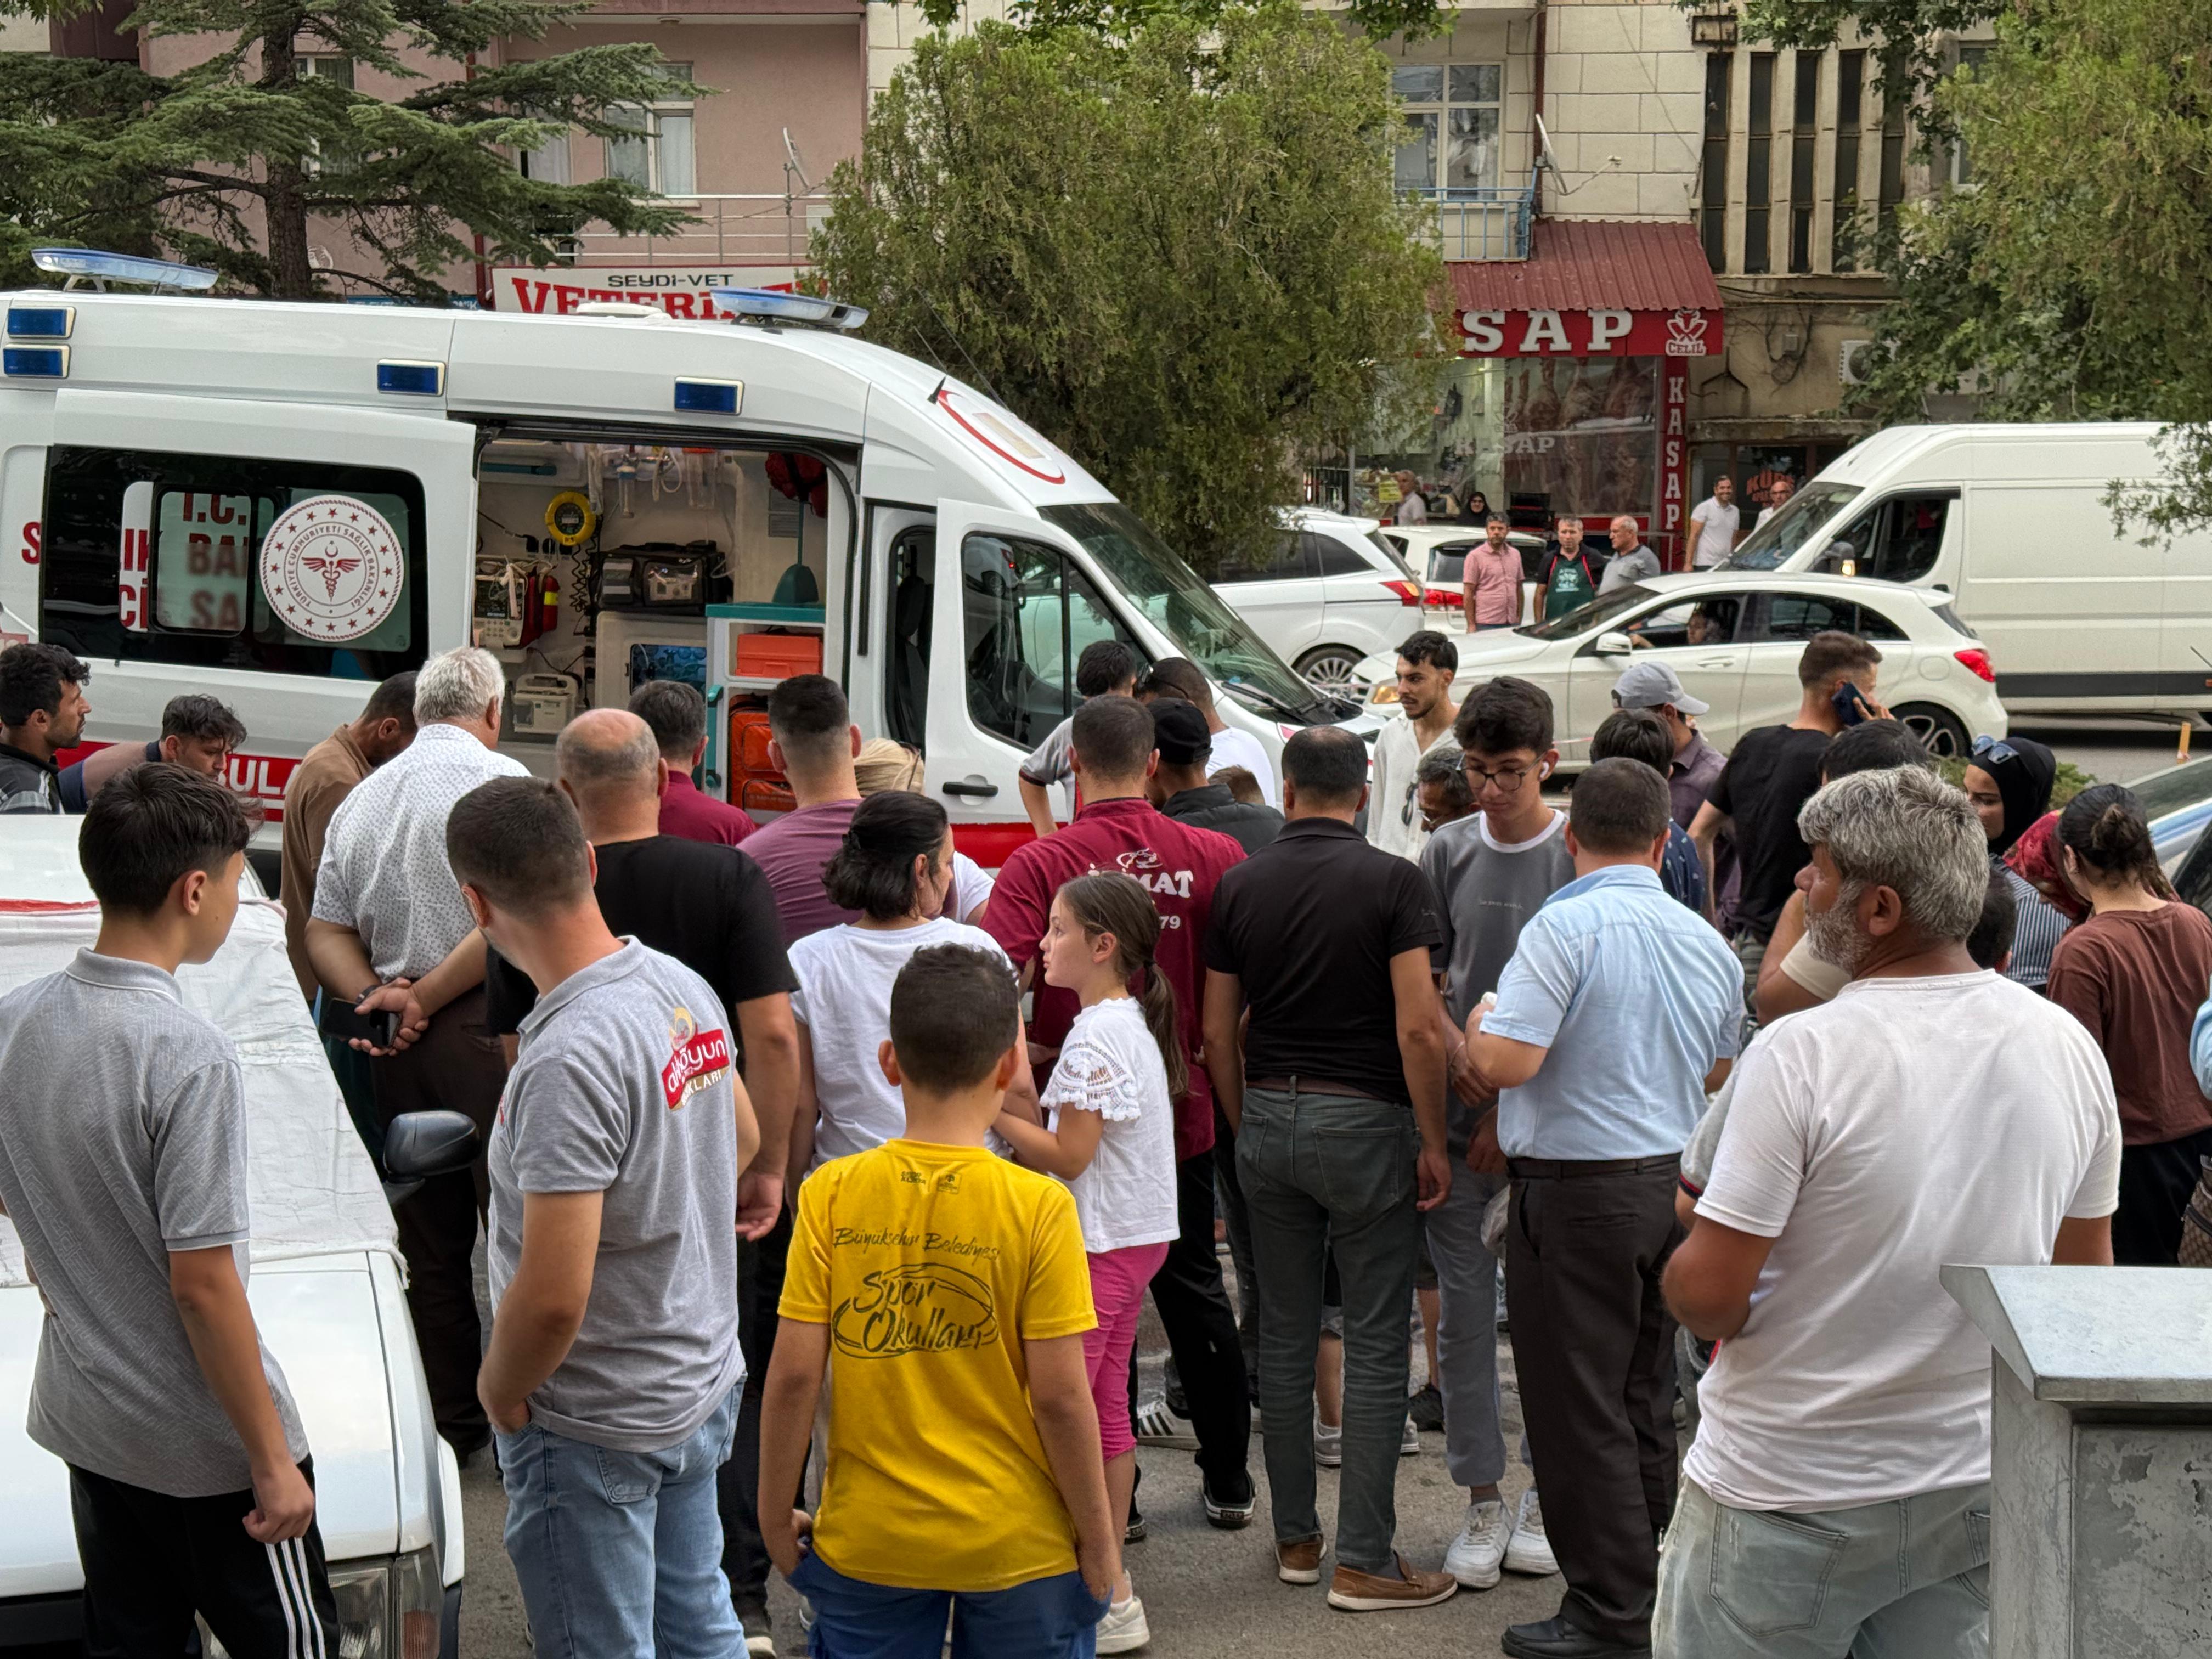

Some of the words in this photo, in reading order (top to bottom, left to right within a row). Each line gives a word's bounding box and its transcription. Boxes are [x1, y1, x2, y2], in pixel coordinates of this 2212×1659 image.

[1418, 309, 1633, 352] SAP
[1454, 437, 1555, 457] KSAP
[1664, 377, 1685, 530] KASAP
[287, 570, 312, 607] TÜRKİYE
[1158, 915, 1181, 930] 79
